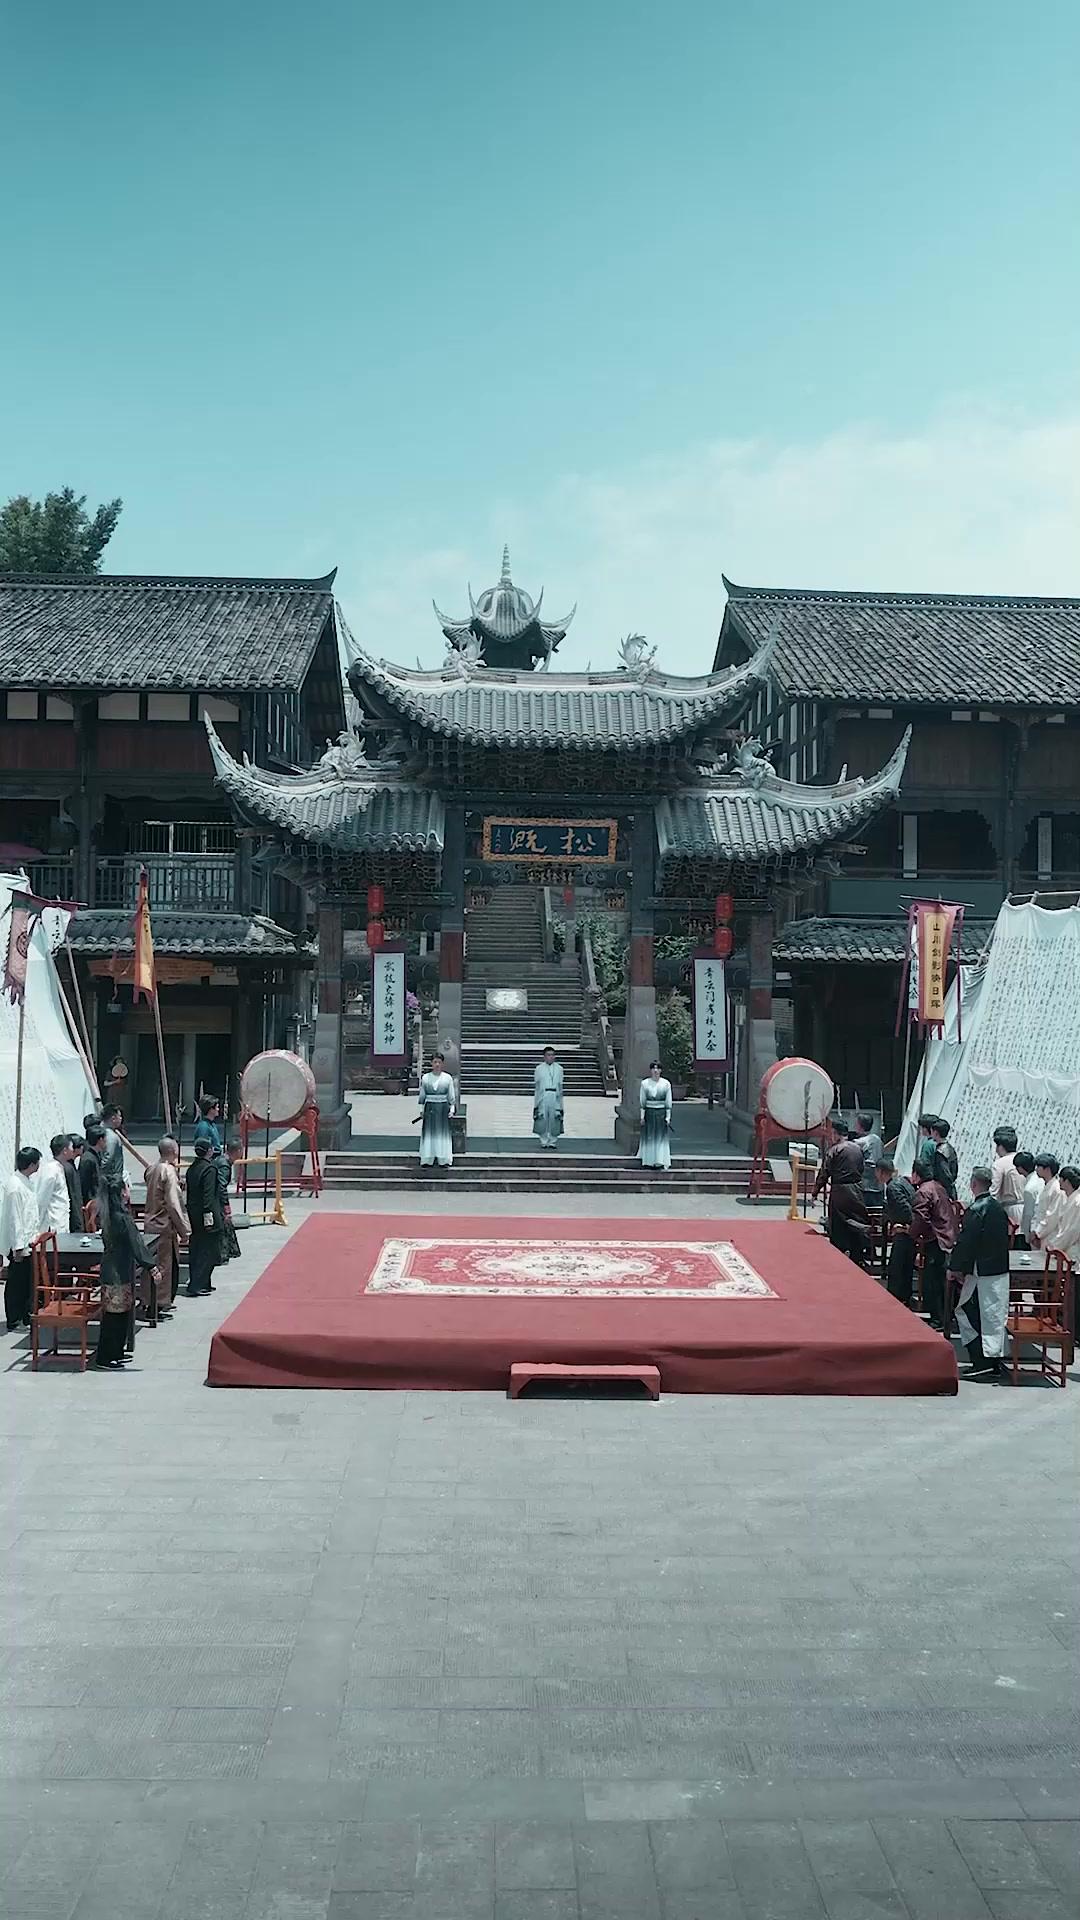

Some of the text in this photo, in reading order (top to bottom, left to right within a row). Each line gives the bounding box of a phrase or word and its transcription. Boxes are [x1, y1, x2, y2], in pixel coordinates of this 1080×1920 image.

[704, 967, 717, 1052] 青云门考核大会
